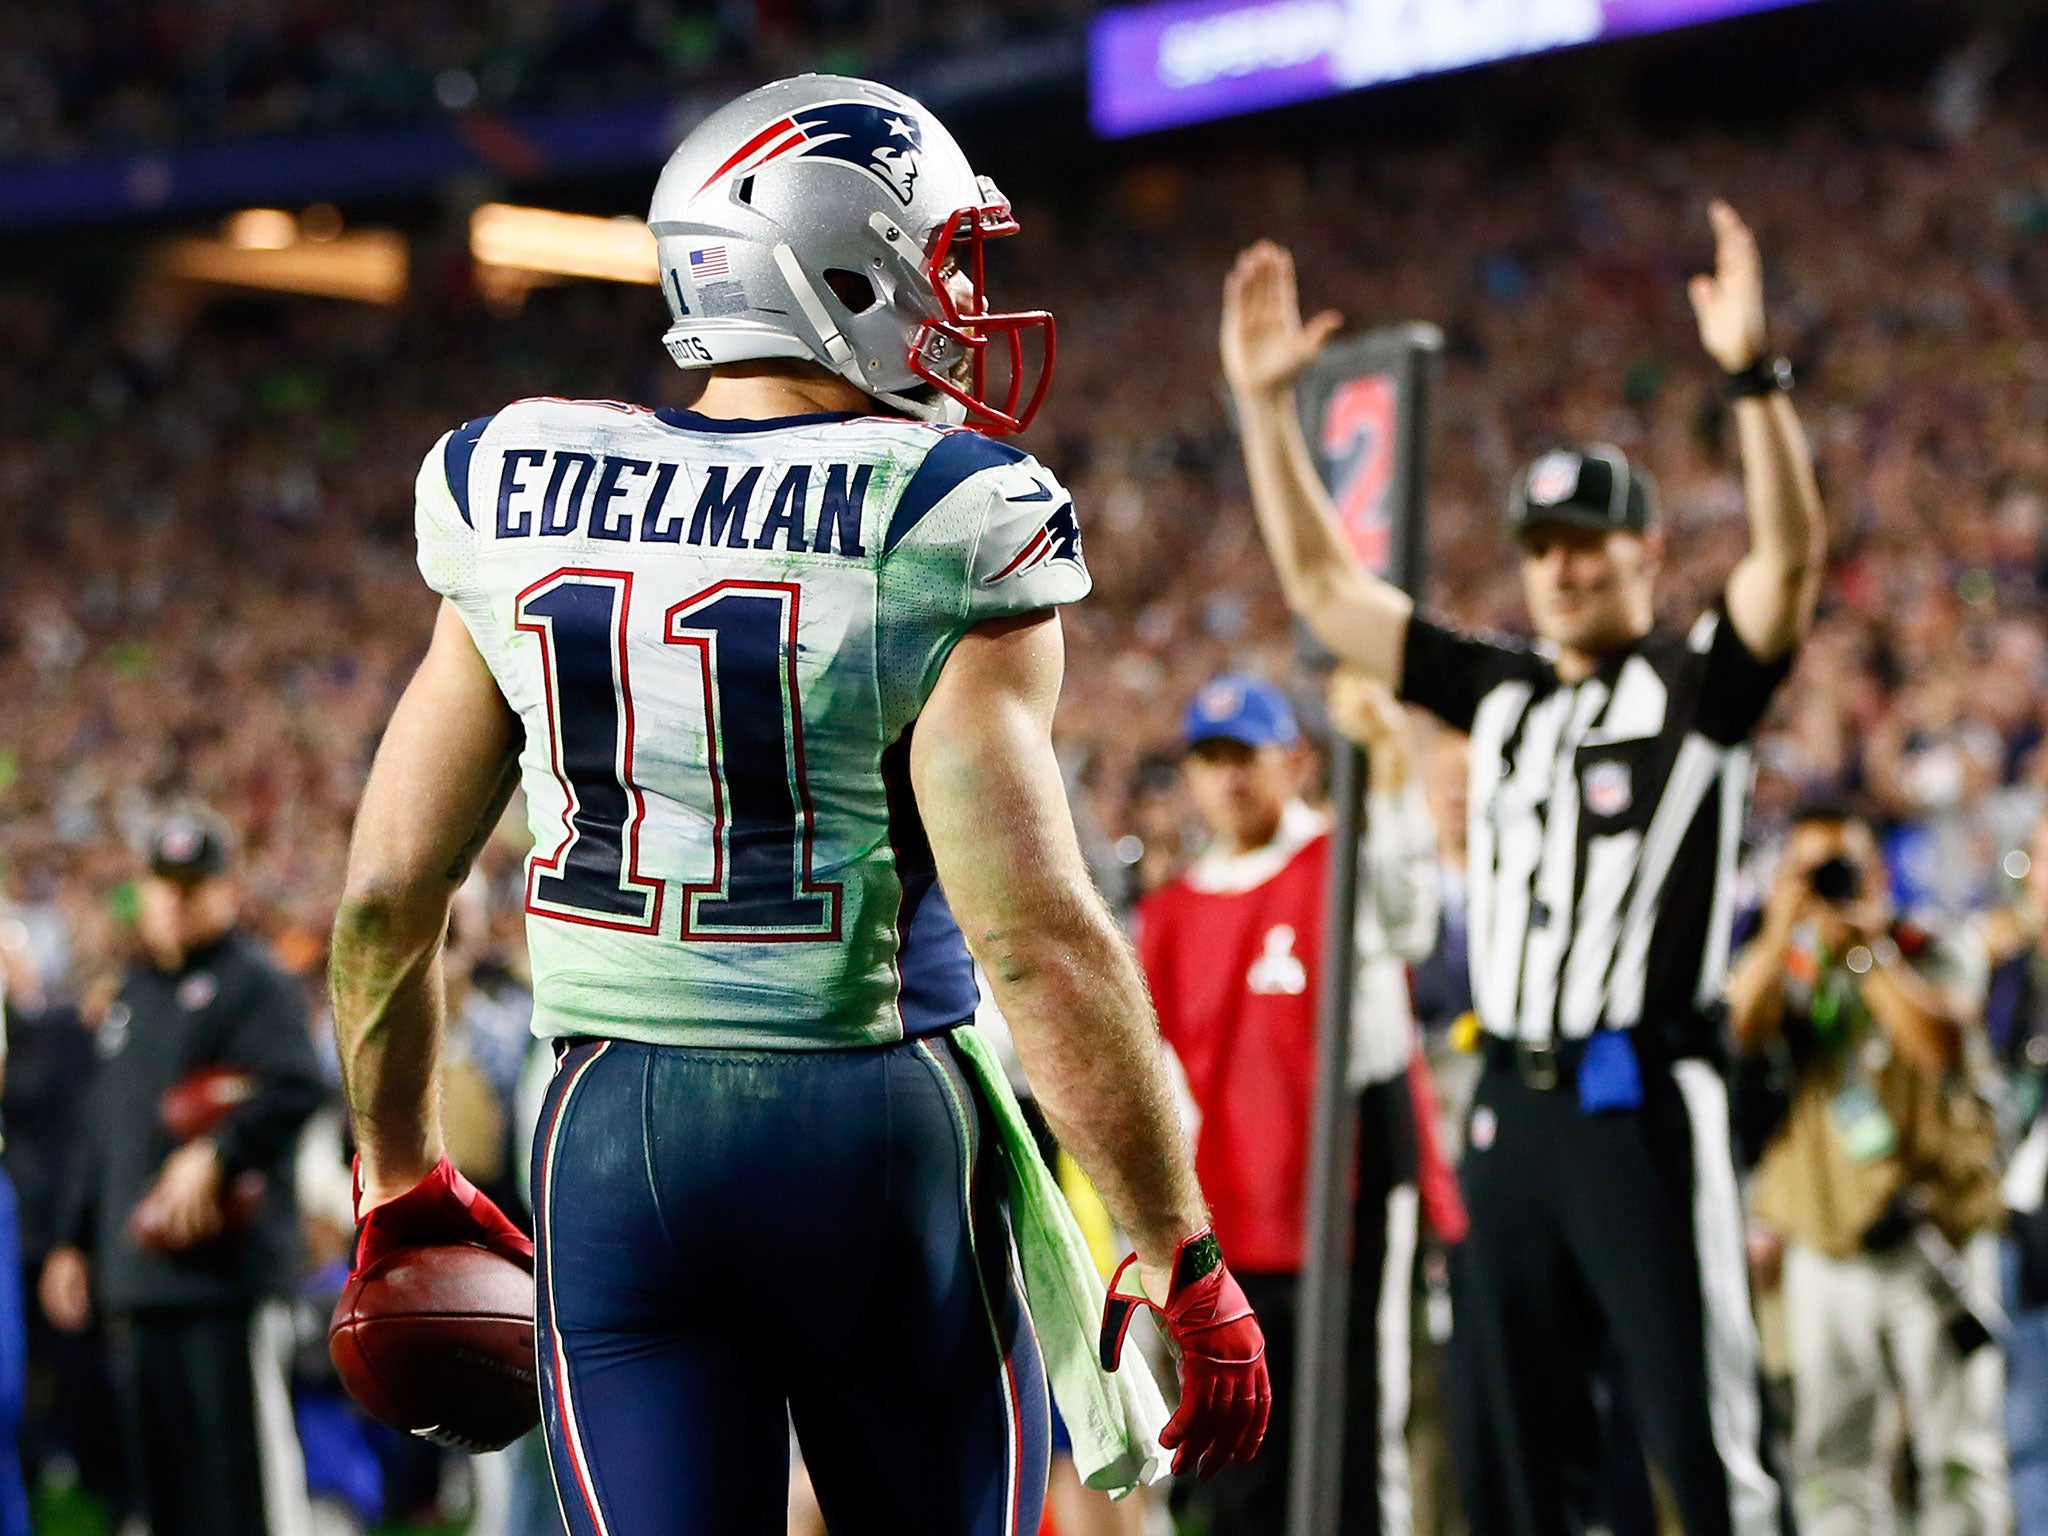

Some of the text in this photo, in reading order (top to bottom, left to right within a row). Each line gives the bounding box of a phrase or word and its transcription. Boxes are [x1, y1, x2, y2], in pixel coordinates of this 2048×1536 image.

[495, 449, 873, 557] EDELMAN
[1323, 375, 1396, 573] 2
[515, 566, 843, 942] 11
